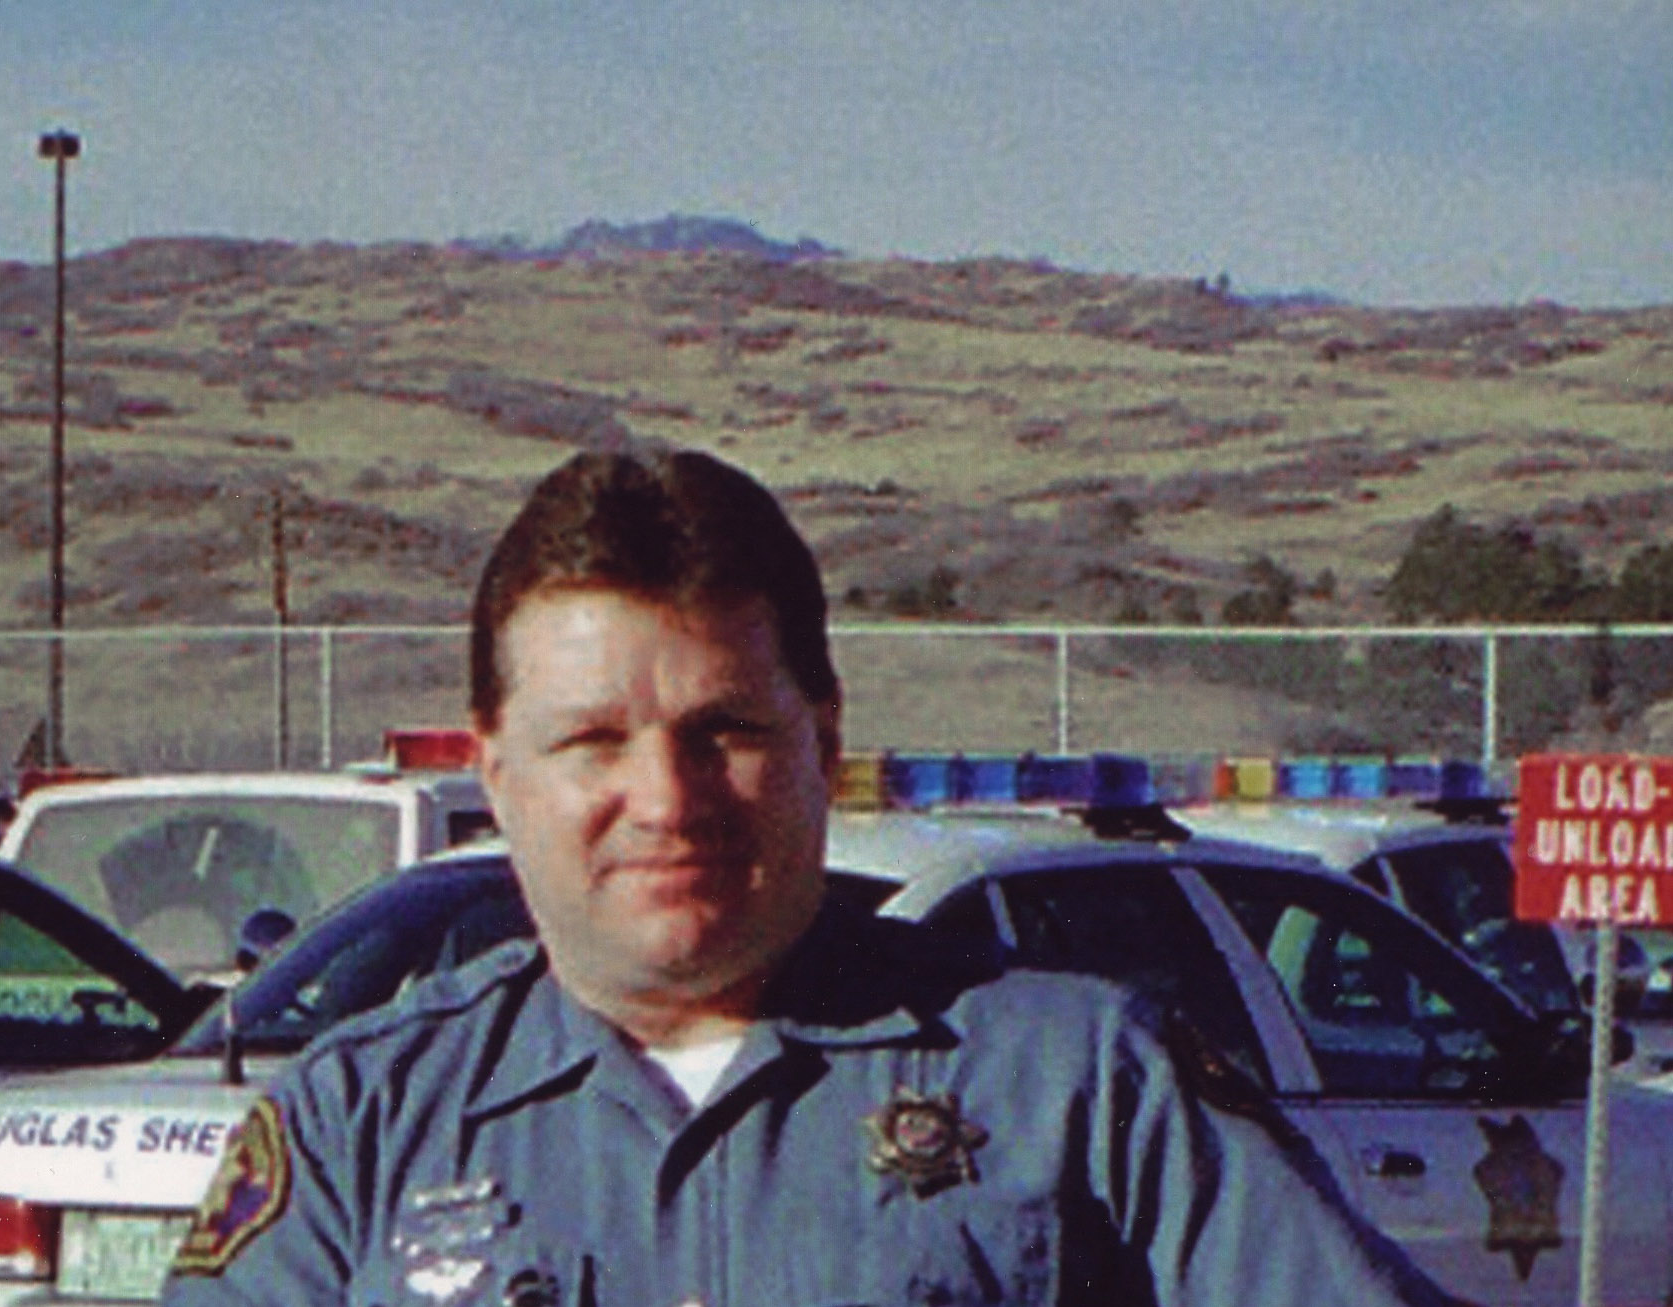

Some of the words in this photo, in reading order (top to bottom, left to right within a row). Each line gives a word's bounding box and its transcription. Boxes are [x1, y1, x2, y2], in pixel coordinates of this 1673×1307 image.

[1556, 763, 1671, 811] LOAD-
[1558, 873, 1659, 922] AREA
[137, 1115, 234, 1156] SHE
